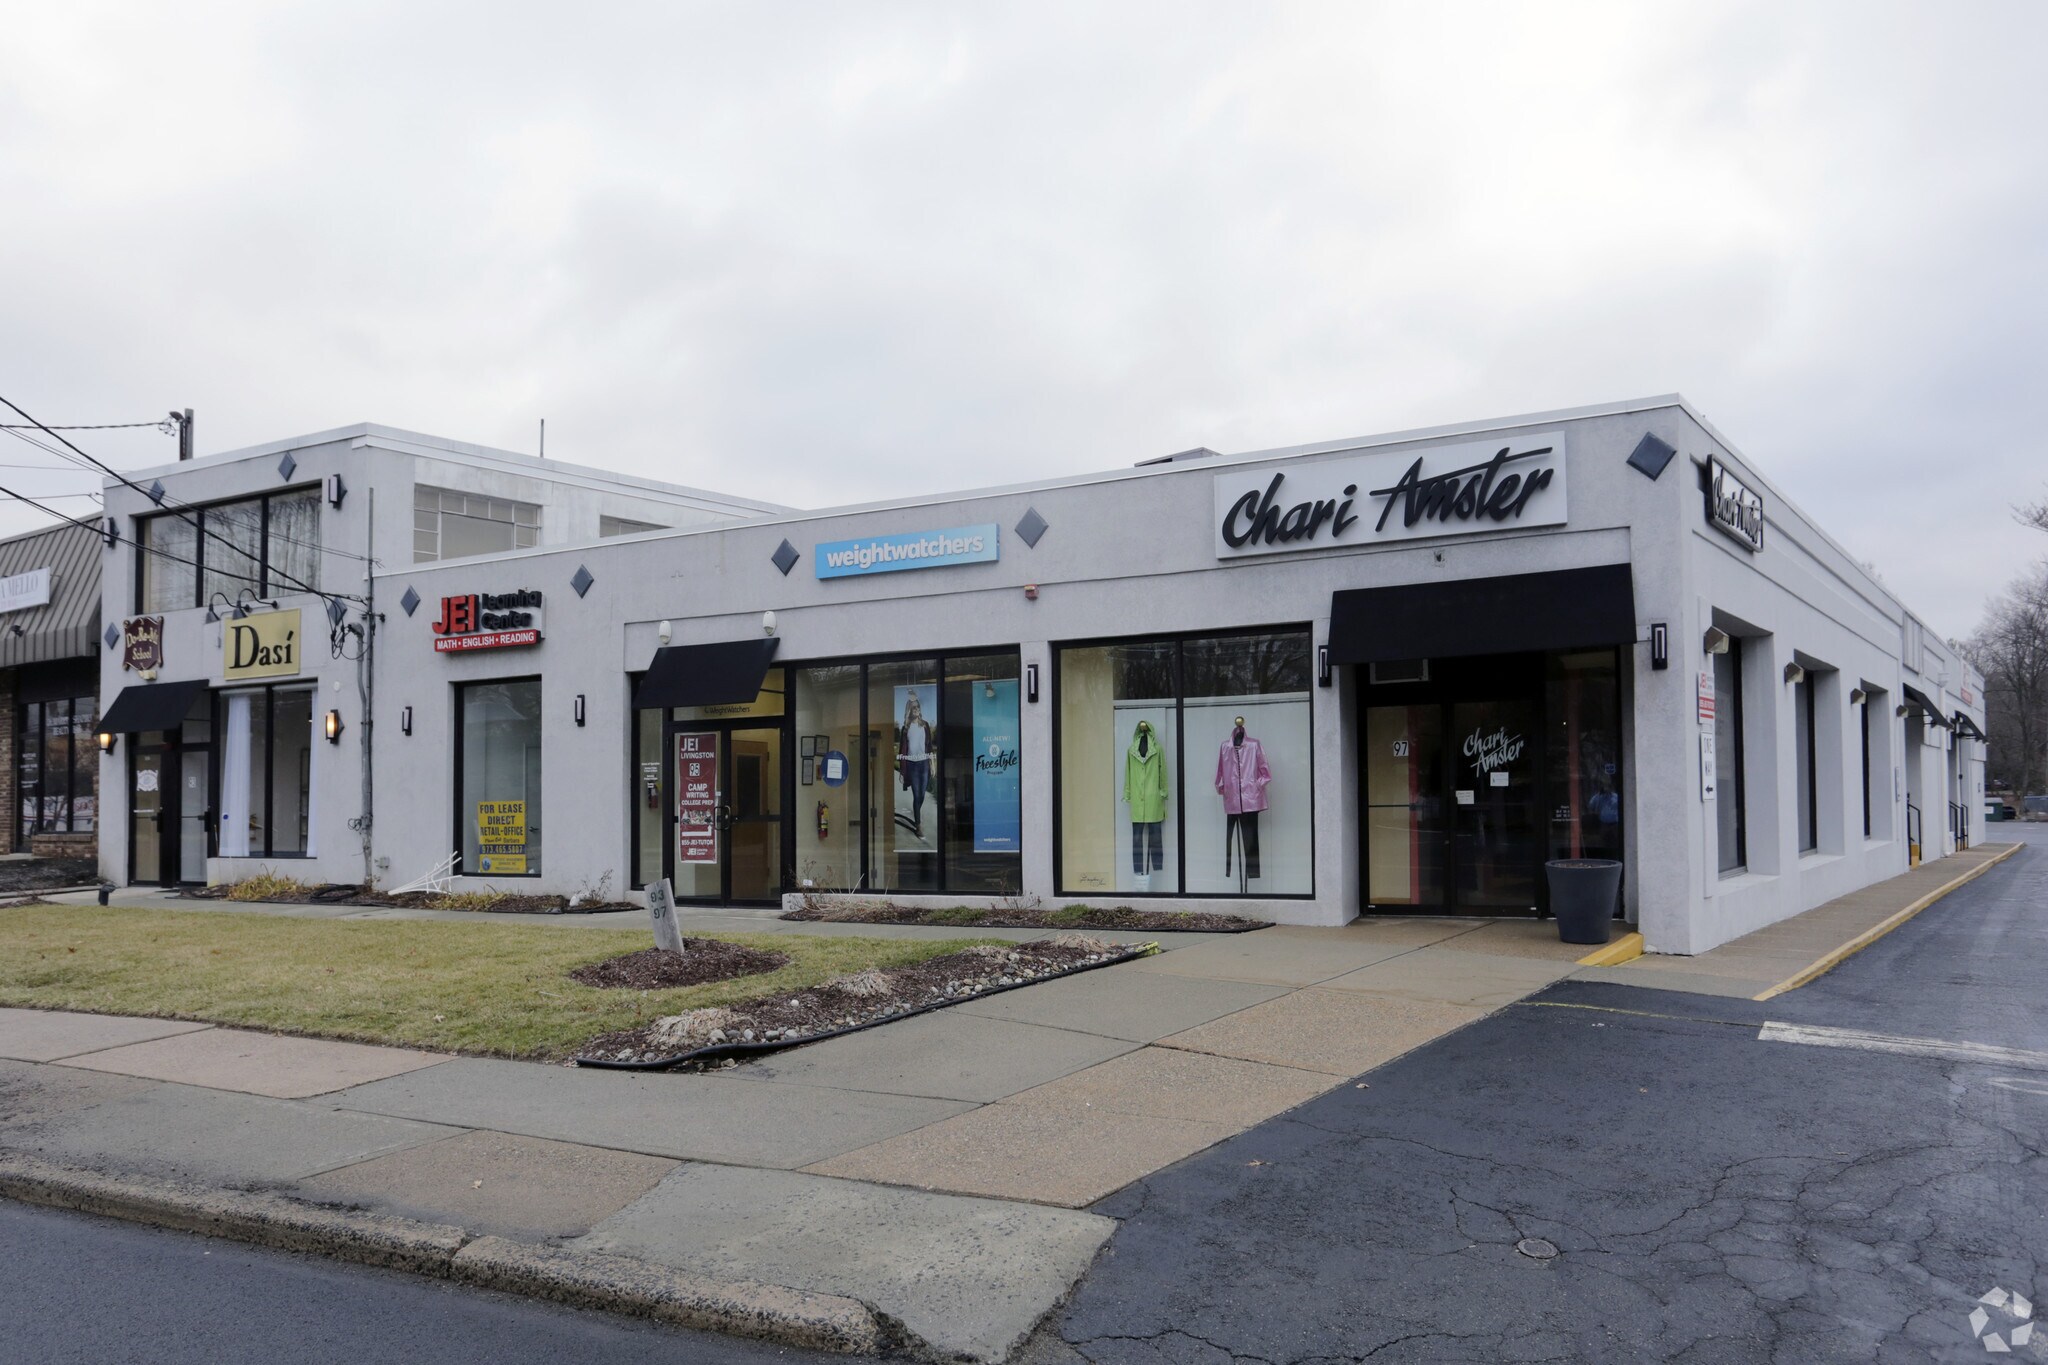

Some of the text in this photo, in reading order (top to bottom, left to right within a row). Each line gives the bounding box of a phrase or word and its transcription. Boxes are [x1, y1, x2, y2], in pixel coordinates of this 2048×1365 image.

[1222, 447, 1553, 548] Chari Amster
[827, 534, 984, 569] weightwatchers
[432, 594, 479, 635] JEI
[481, 610, 532, 629] Center
[229, 625, 294, 669] Dasí
[437, 632, 535, 650] MATH ENGLISH READING
[132, 647, 152, 661] School
[681, 738, 699, 751] JEI
[1463, 726, 1508, 756] Chari
[1394, 742, 1408, 755] 97
[1470, 734, 1525, 777] Amster
[976, 749, 1018, 772] Freestyle
[690, 763, 699, 776] 95
[688, 783, 708, 791] CAMP
[480, 803, 523, 814] FOR LEASE
[487, 815, 515, 825] DIRECT
[687, 848, 697, 856] JEI
[650, 889, 665, 902] 93
[653, 906, 667, 919] 97
